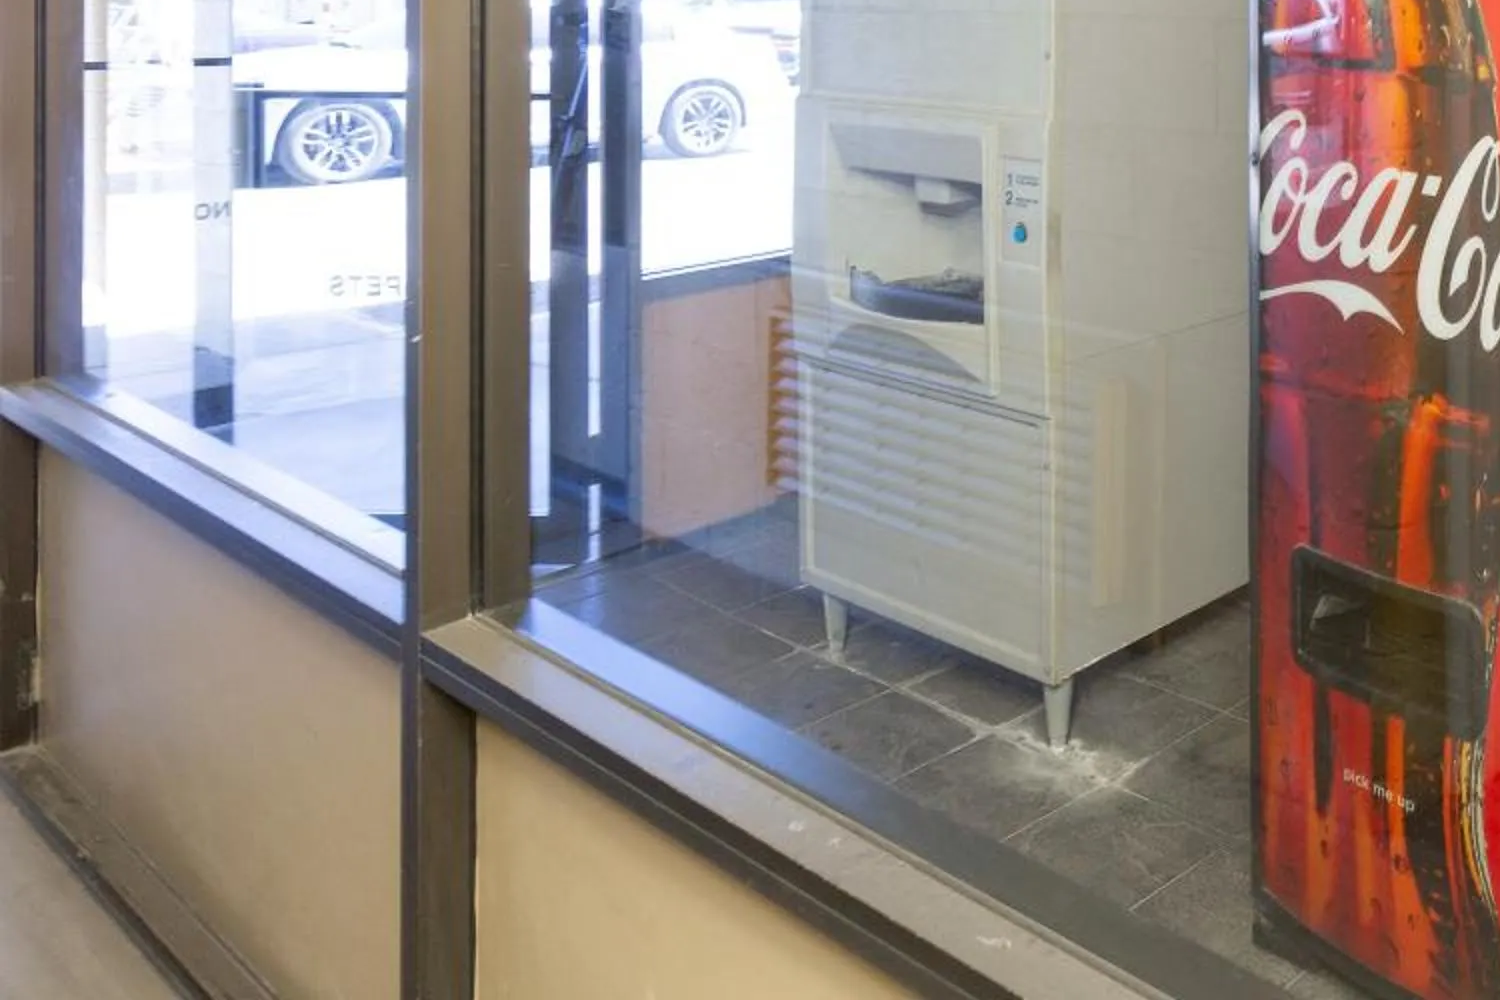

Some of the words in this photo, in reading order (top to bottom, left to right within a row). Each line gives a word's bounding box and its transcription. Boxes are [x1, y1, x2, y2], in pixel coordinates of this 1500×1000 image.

[1004, 190, 1014, 205] 2
[1372, 783, 1394, 803] me
[1396, 794, 1416, 814] up
